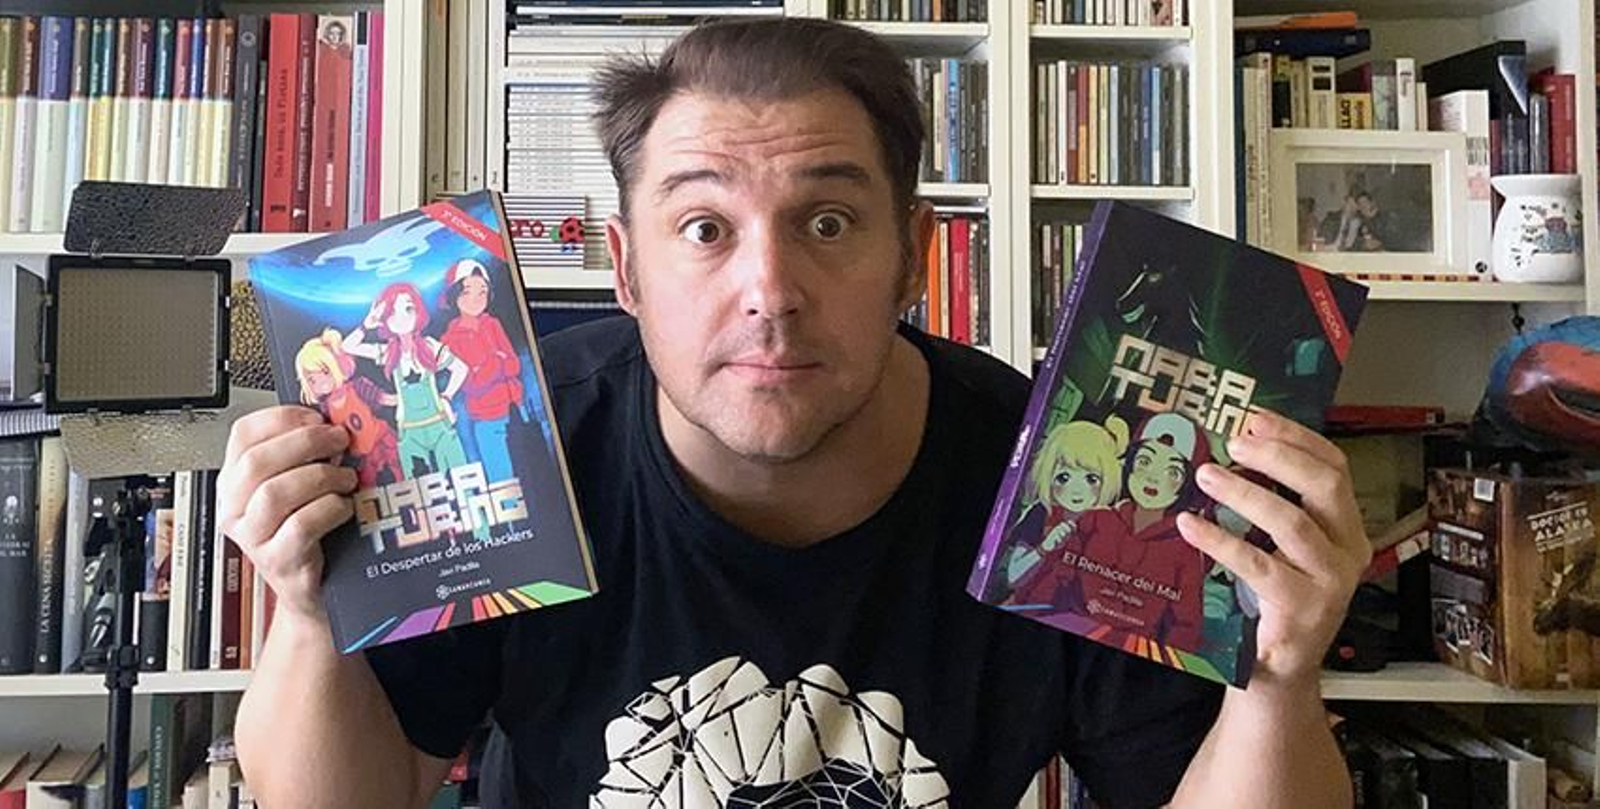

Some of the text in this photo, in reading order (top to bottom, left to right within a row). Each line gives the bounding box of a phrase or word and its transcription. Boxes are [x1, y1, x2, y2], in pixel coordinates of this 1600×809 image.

[366, 528, 535, 579] El Despertar de los Hackers
[1062, 551, 1182, 601] El Renacer del Mal
[41, 584, 52, 617] CENA
[40, 617, 51, 633] LA
